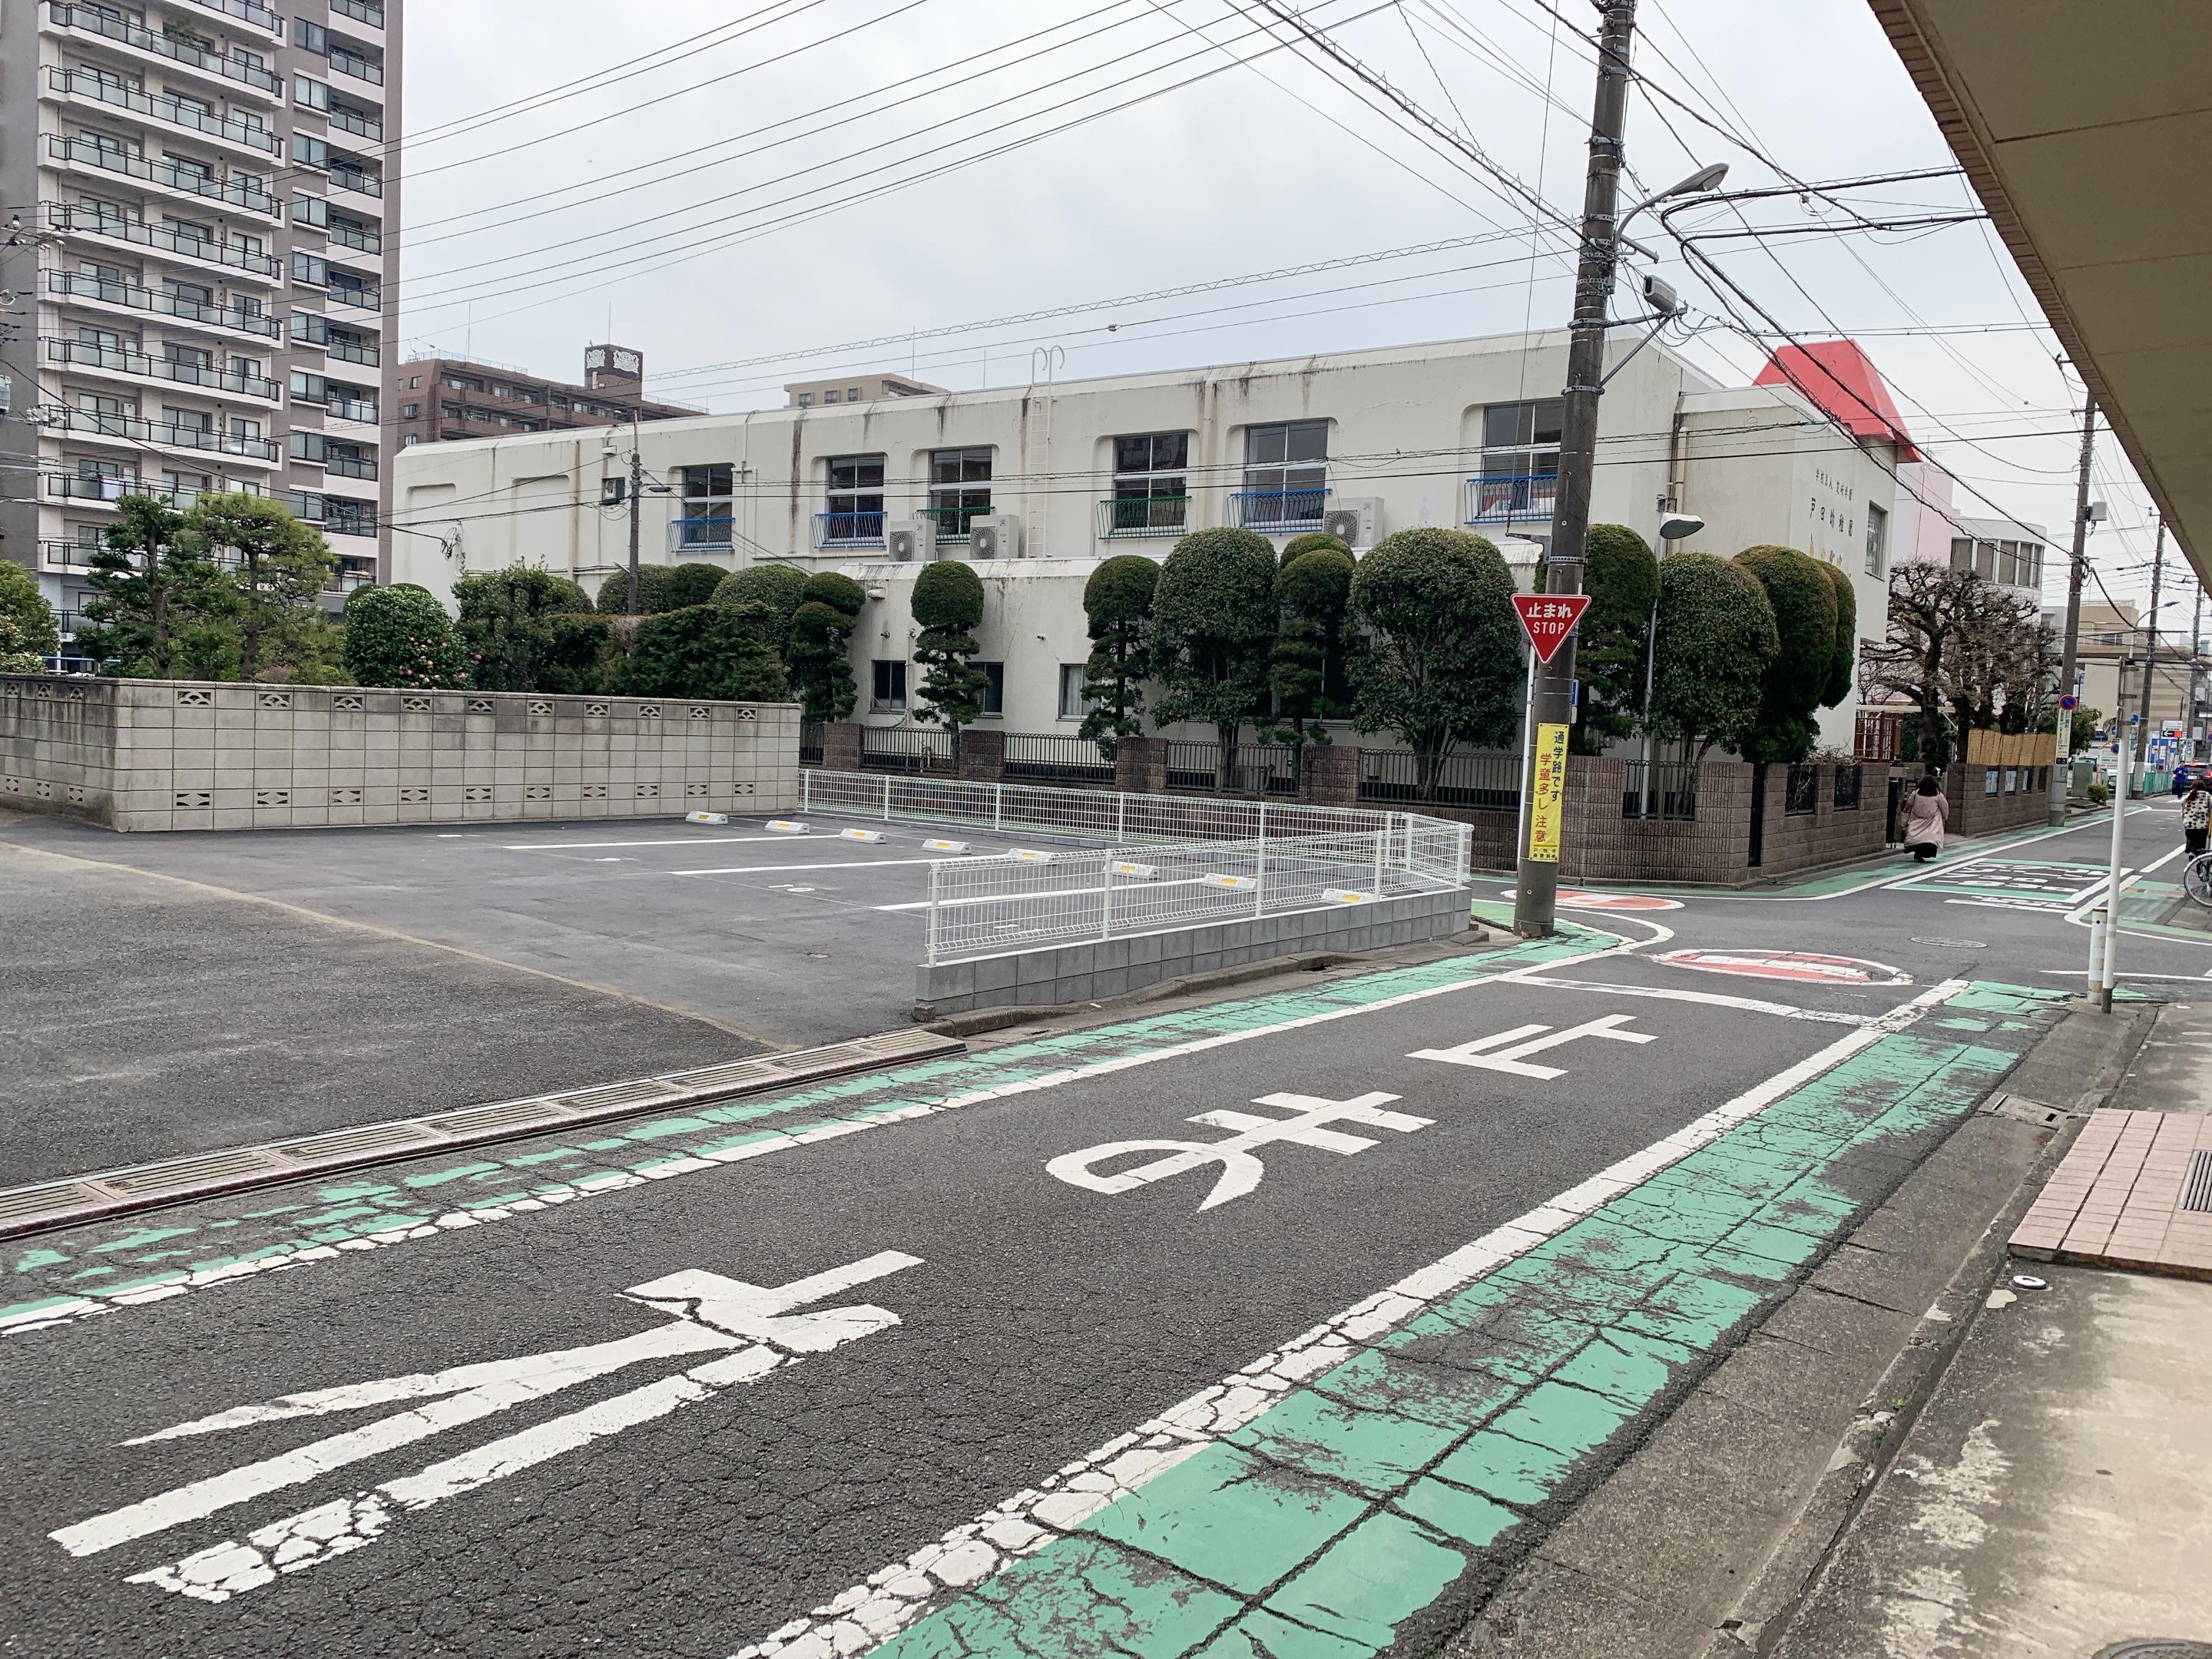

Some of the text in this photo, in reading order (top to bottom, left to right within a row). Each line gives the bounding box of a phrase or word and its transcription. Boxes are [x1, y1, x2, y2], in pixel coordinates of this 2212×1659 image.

[1525, 602, 1573, 619] 止まれ
[1533, 621, 1565, 634] STOP
[1551, 731, 1565, 802] 通学路です
[1535, 753, 1552, 843] 学童多し注意
